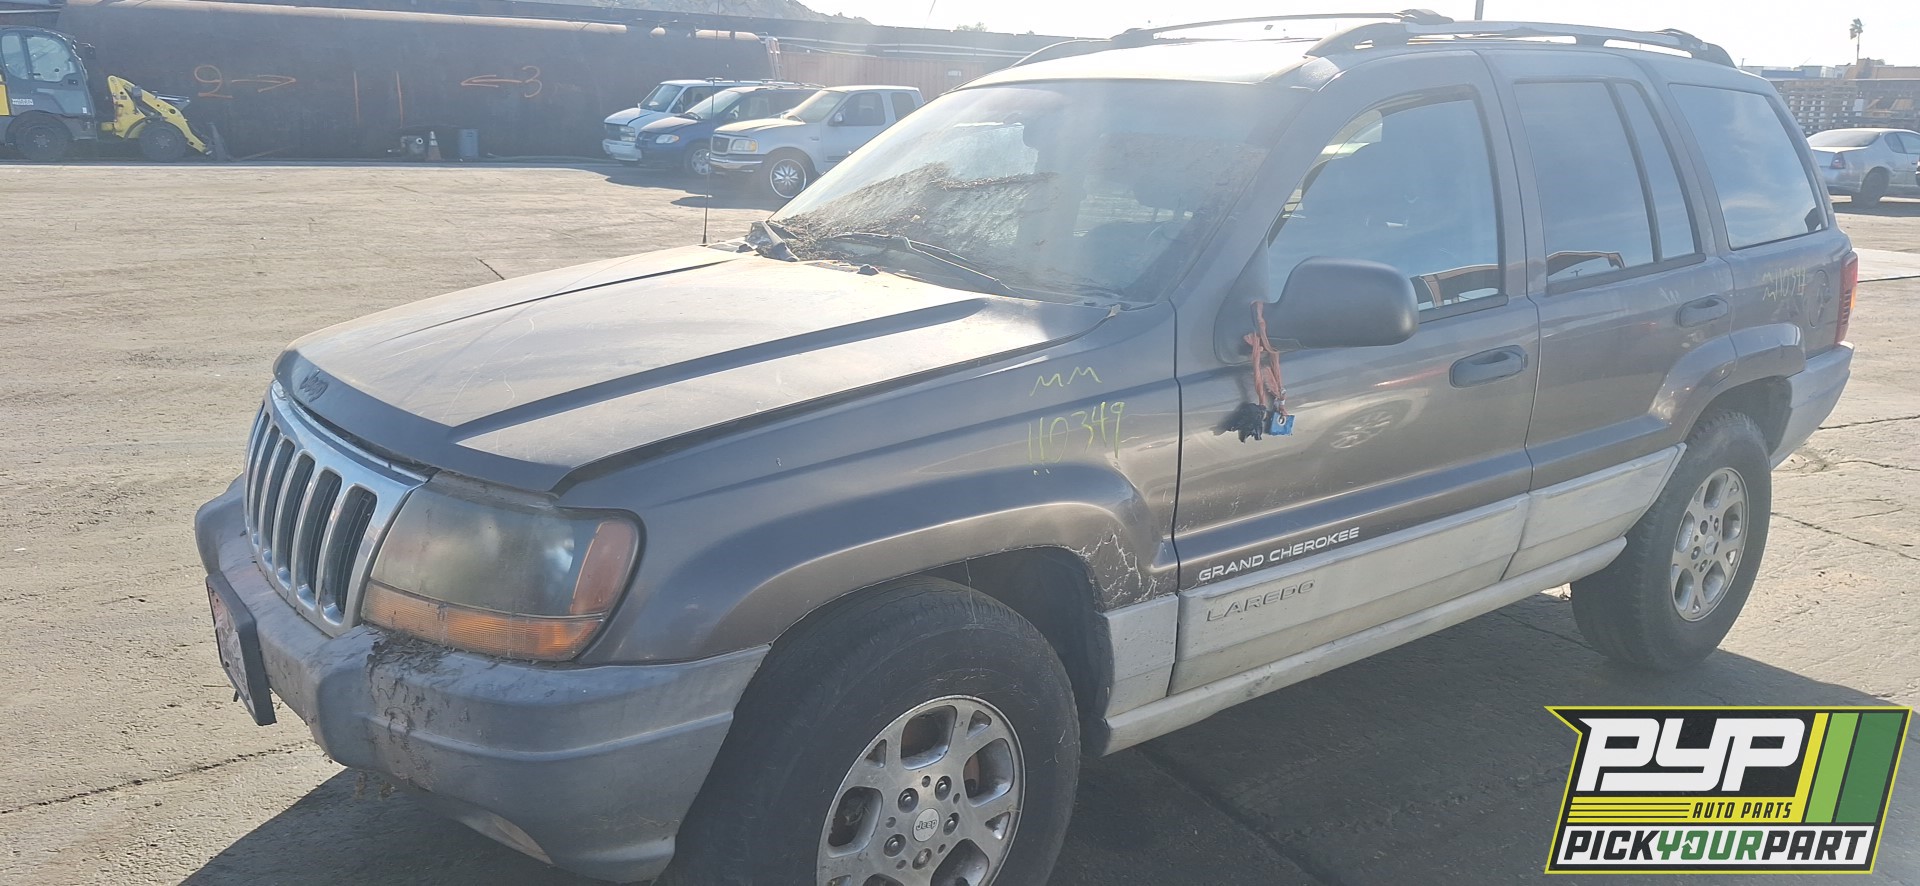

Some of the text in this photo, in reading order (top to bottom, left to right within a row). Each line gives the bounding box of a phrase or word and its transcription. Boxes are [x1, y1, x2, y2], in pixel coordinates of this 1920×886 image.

[194, 64, 233, 98] 2
[521, 65, 542, 98] 3
[1028, 401, 1126, 465] 110349
[1198, 527, 1359, 581] GRAND CHEROKEE
[1206, 579, 1316, 622] LAREDO
